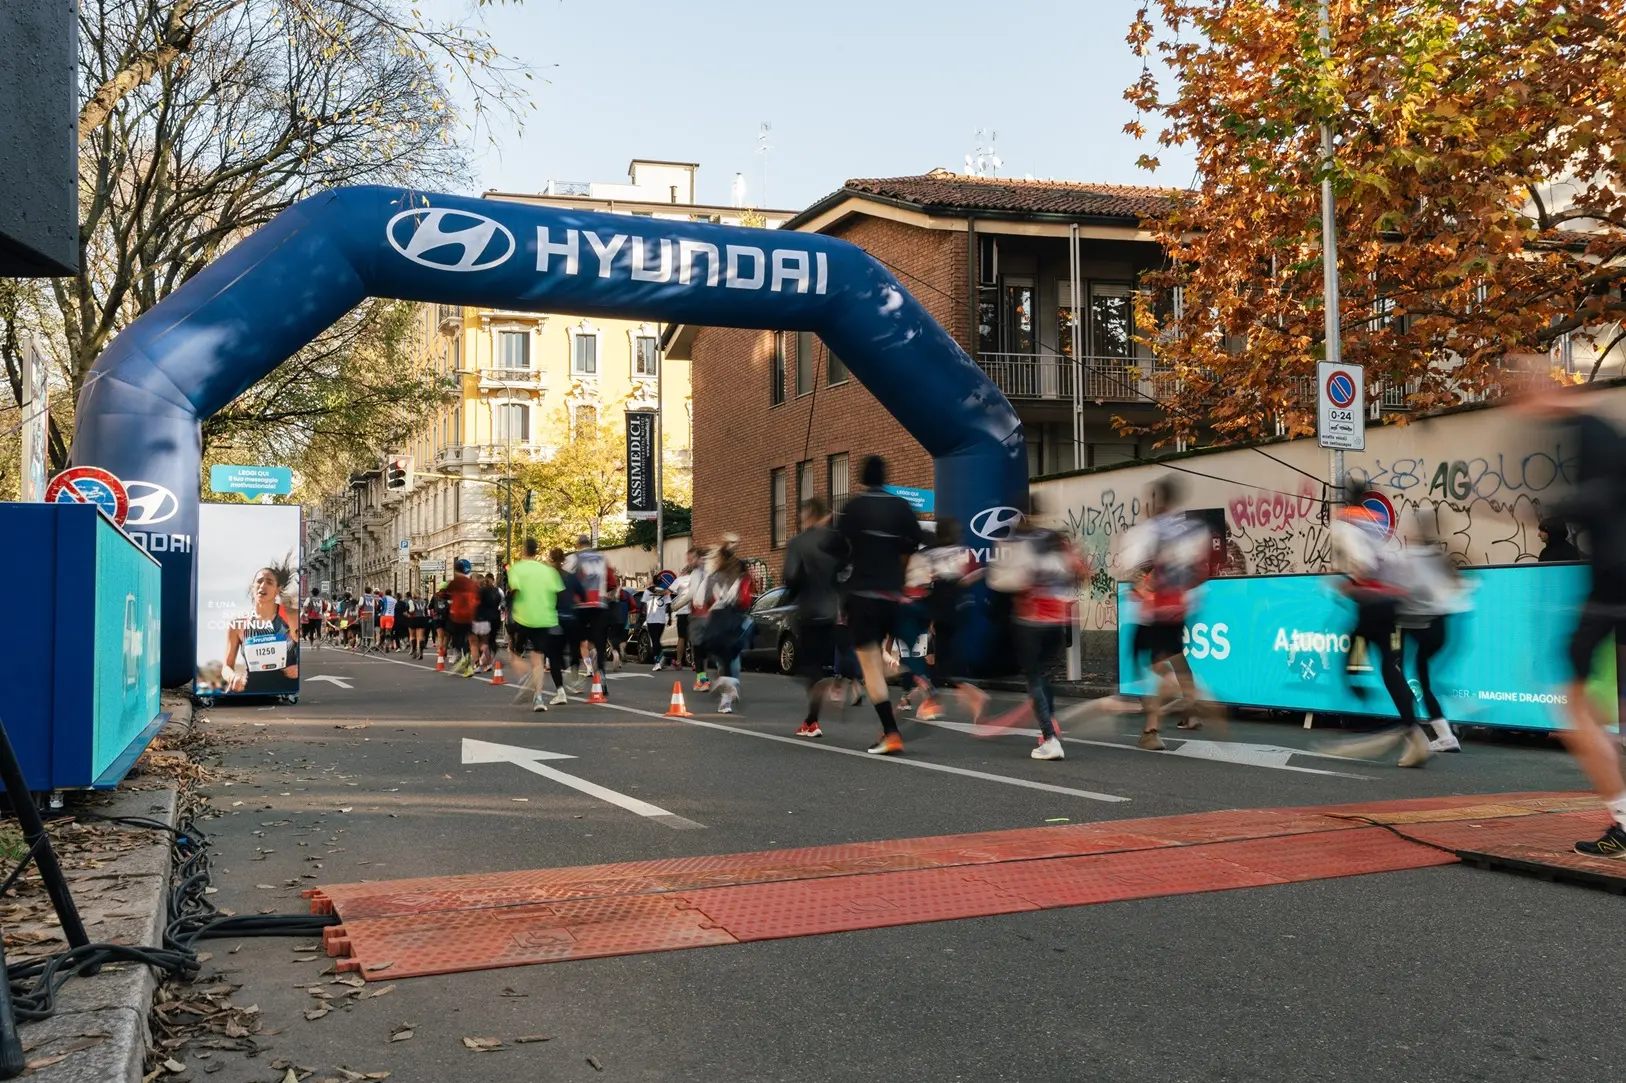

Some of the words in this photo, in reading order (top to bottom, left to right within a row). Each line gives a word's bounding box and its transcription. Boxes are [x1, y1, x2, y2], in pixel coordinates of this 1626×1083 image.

[535, 226, 828, 294] HYUNDAI
[1331, 410, 1352, 421] 0-24
[630, 415, 642, 508] ASSIMEDICI.
[1429, 460, 1470, 502] AG
[207, 620, 274, 630] CONTINUA
[255, 646, 276, 657] 11250
[1478, 690, 1518, 702] IMAGINE
[1518, 692, 1569, 705] DRAGONS
